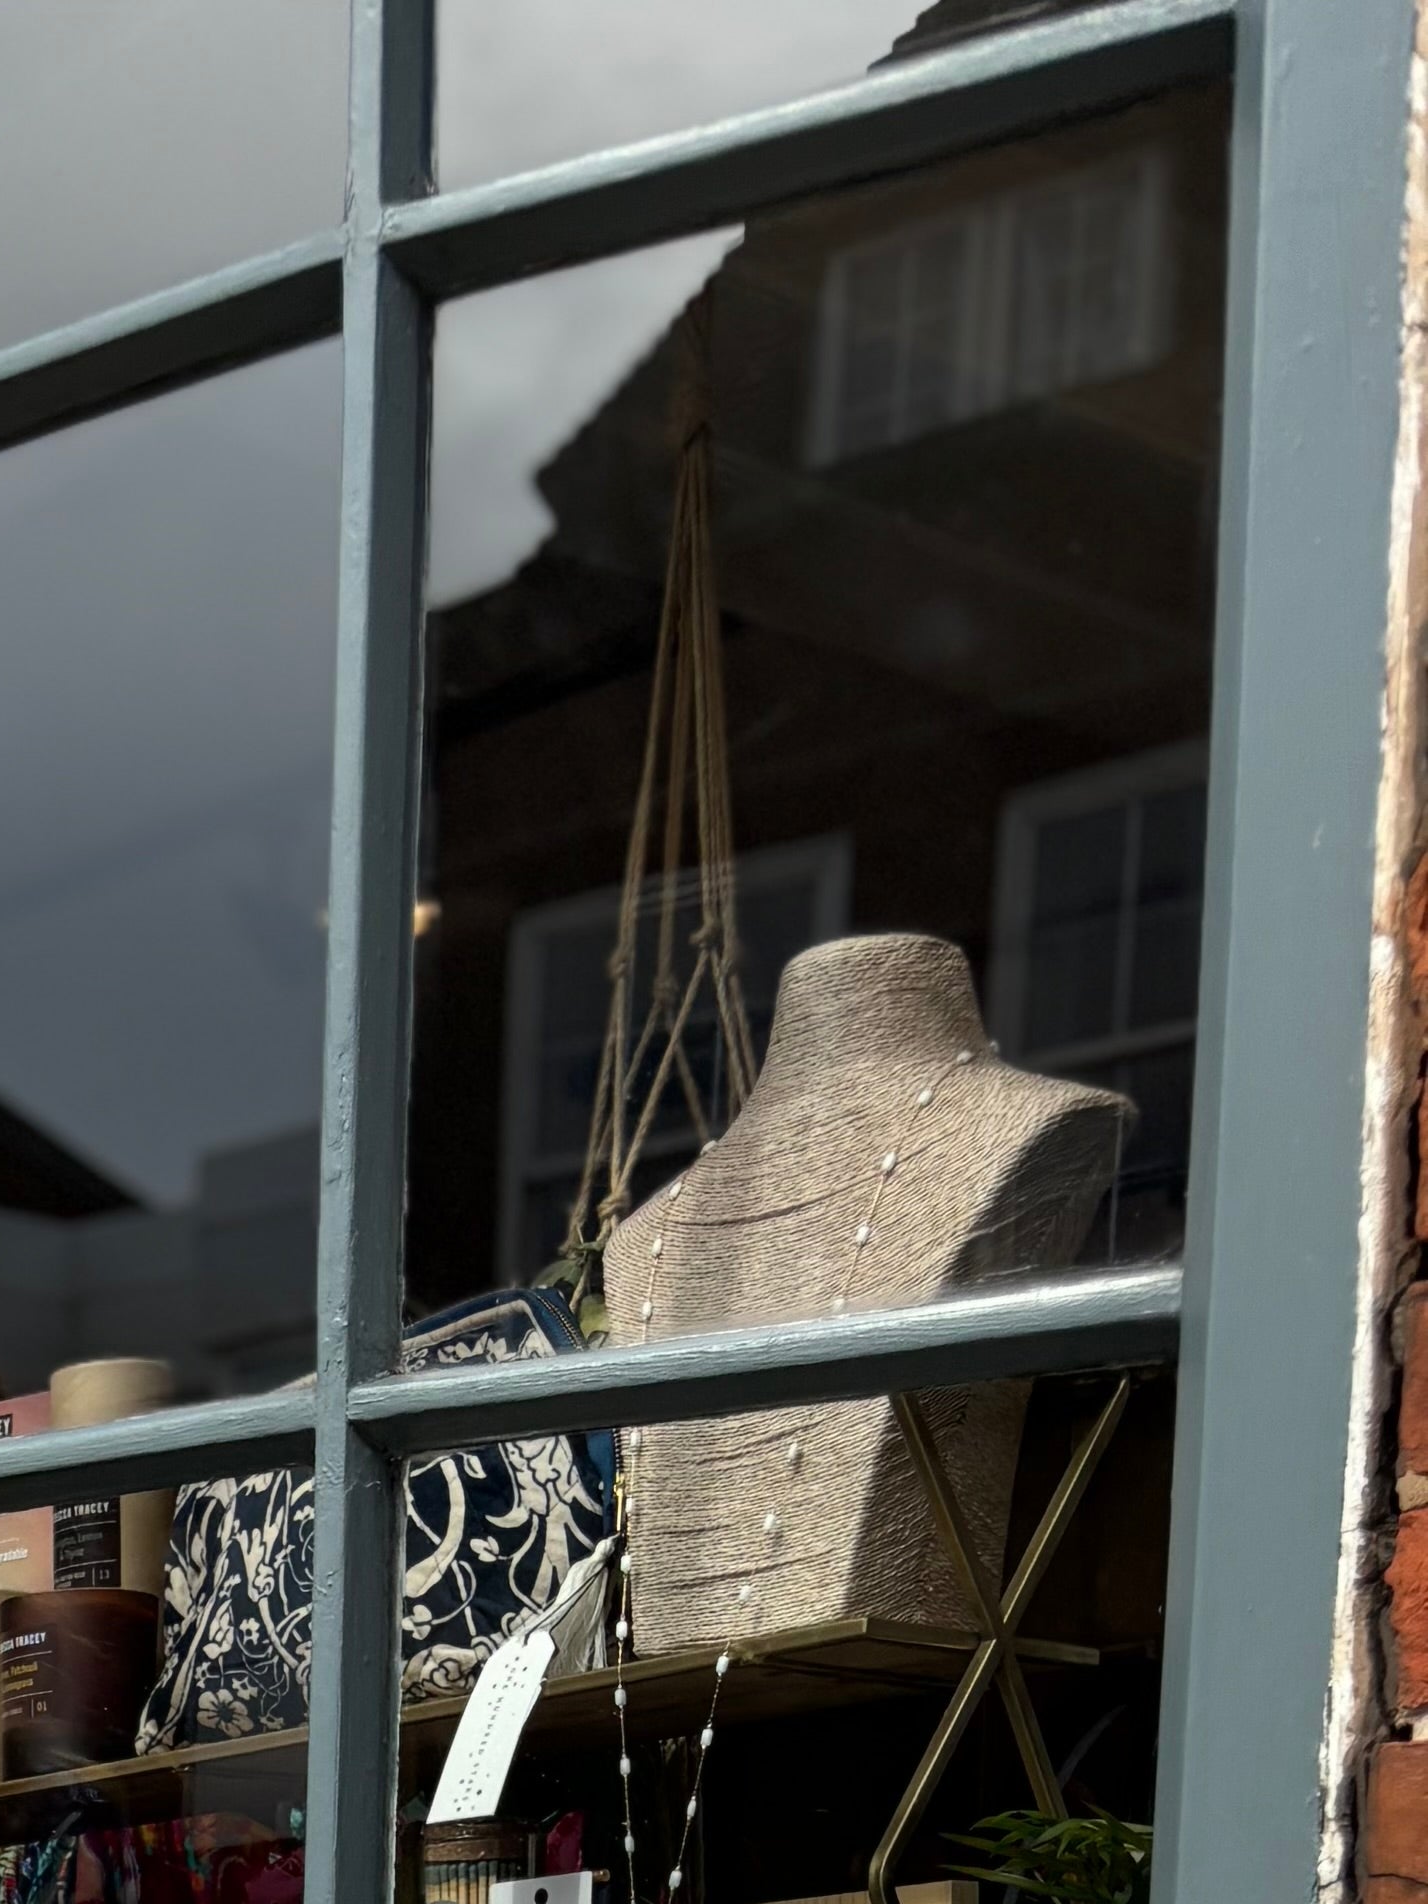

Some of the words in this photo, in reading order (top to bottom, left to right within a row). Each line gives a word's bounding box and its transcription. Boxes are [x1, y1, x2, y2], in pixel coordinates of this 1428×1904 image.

[74, 1501, 110, 1517] TRACEY
[15, 1631, 46, 1649] TRACEY
[36, 1701, 47, 1712] 01
